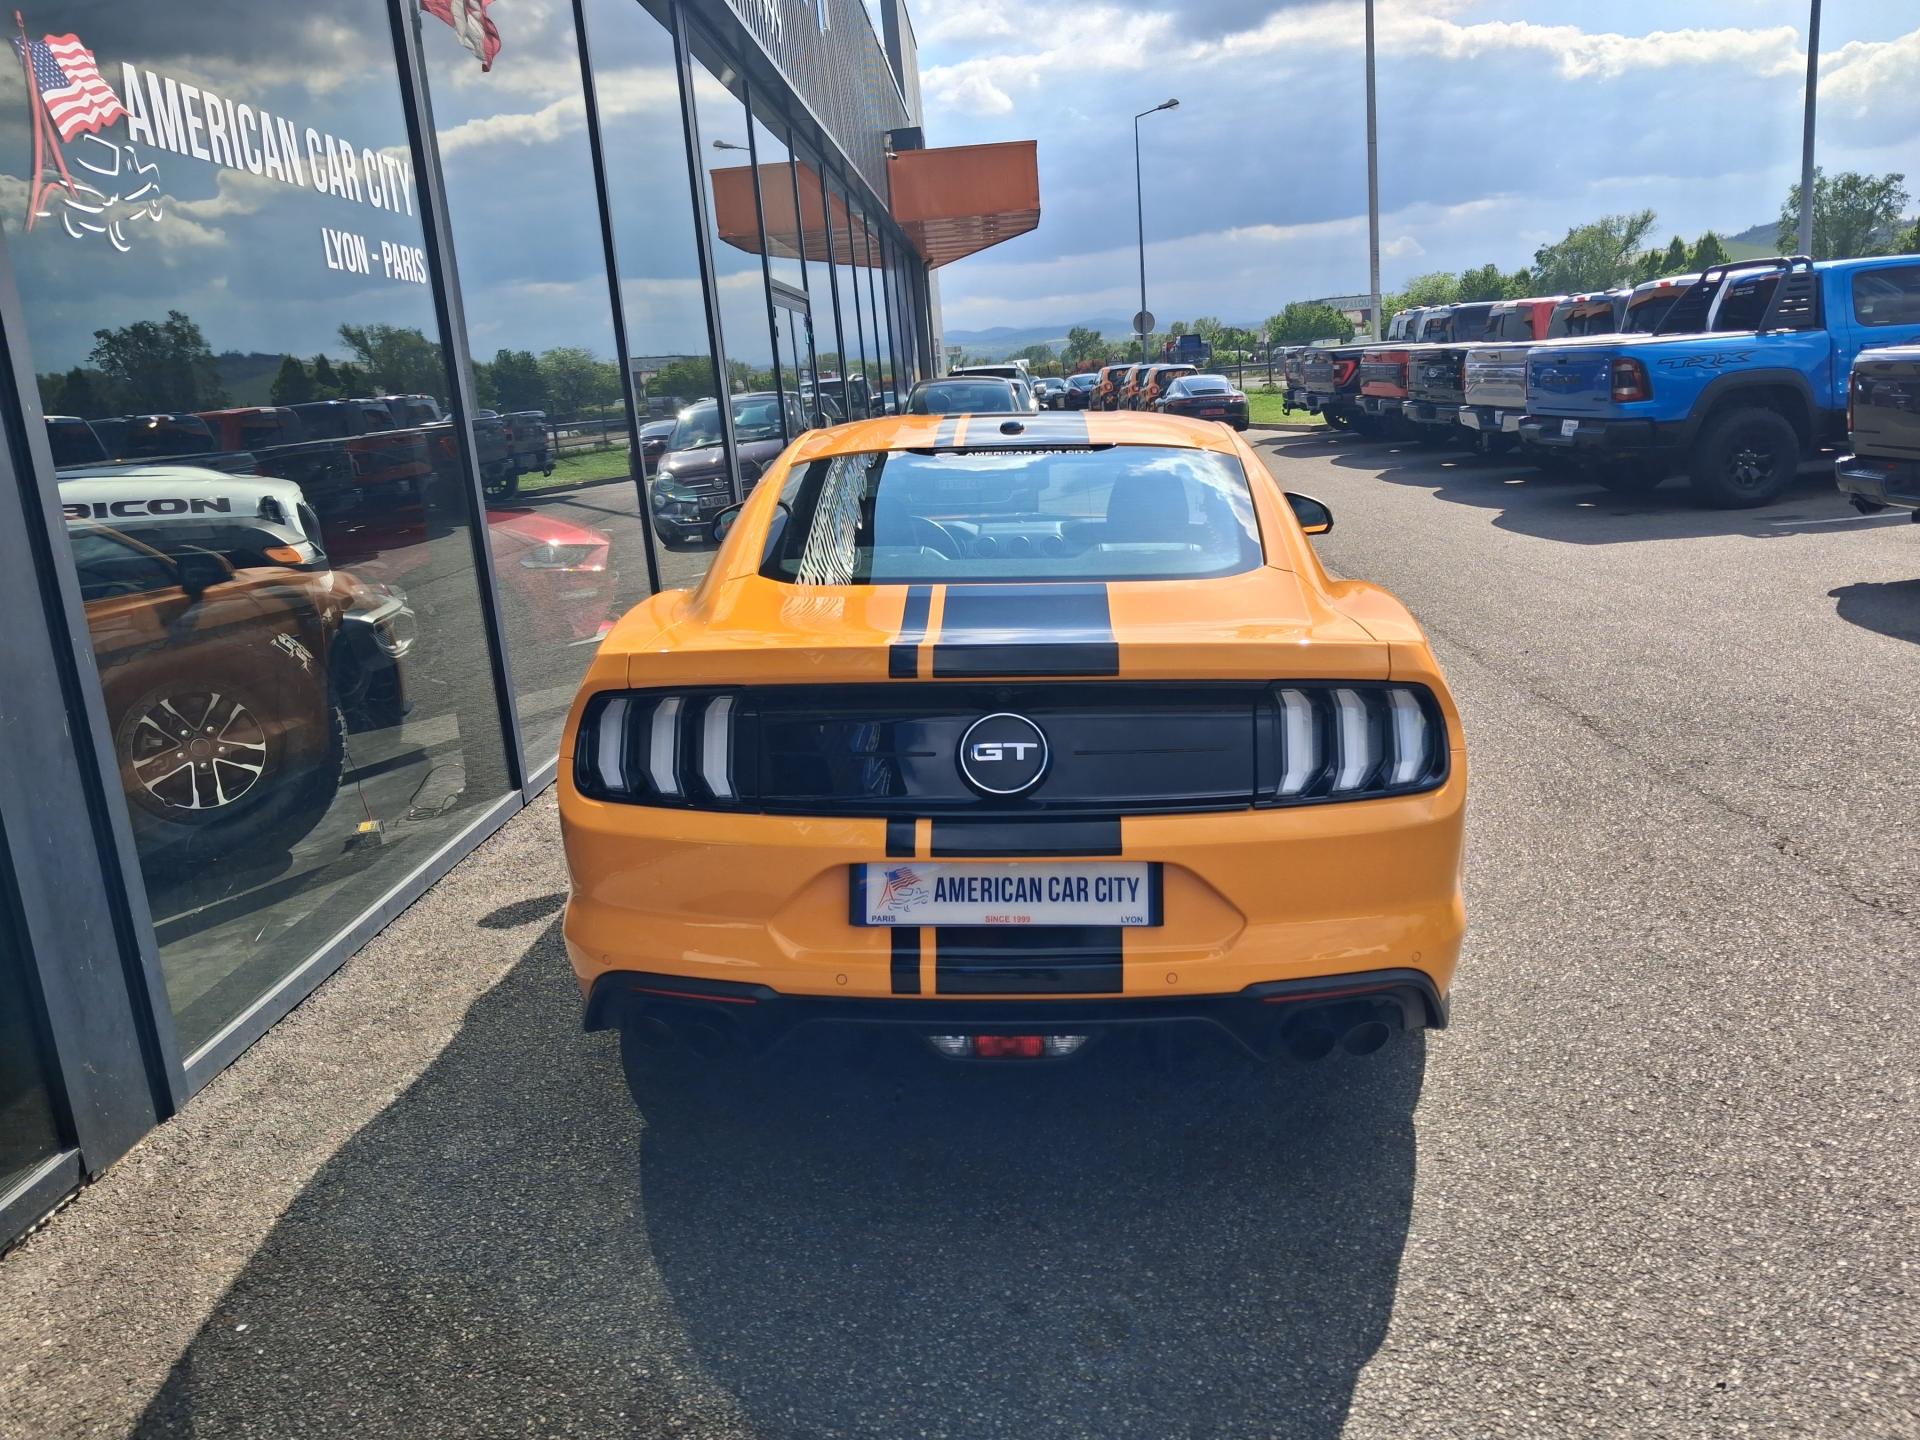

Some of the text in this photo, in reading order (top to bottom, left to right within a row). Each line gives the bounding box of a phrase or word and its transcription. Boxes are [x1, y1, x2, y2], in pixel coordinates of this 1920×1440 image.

[121, 62, 413, 216] AMERICAN CAR CITY
[322, 228, 369, 274] LYON
[382, 241, 427, 284] PARIS
[1657, 350, 1758, 369] TRX
[971, 743, 1038, 761] GT
[934, 877, 1140, 903] AMERICAN CAR CITY
[871, 915, 897, 923] PARIS
[985, 915, 1031, 923] SINCE 1999
[1120, 915, 1143, 924] LYON
